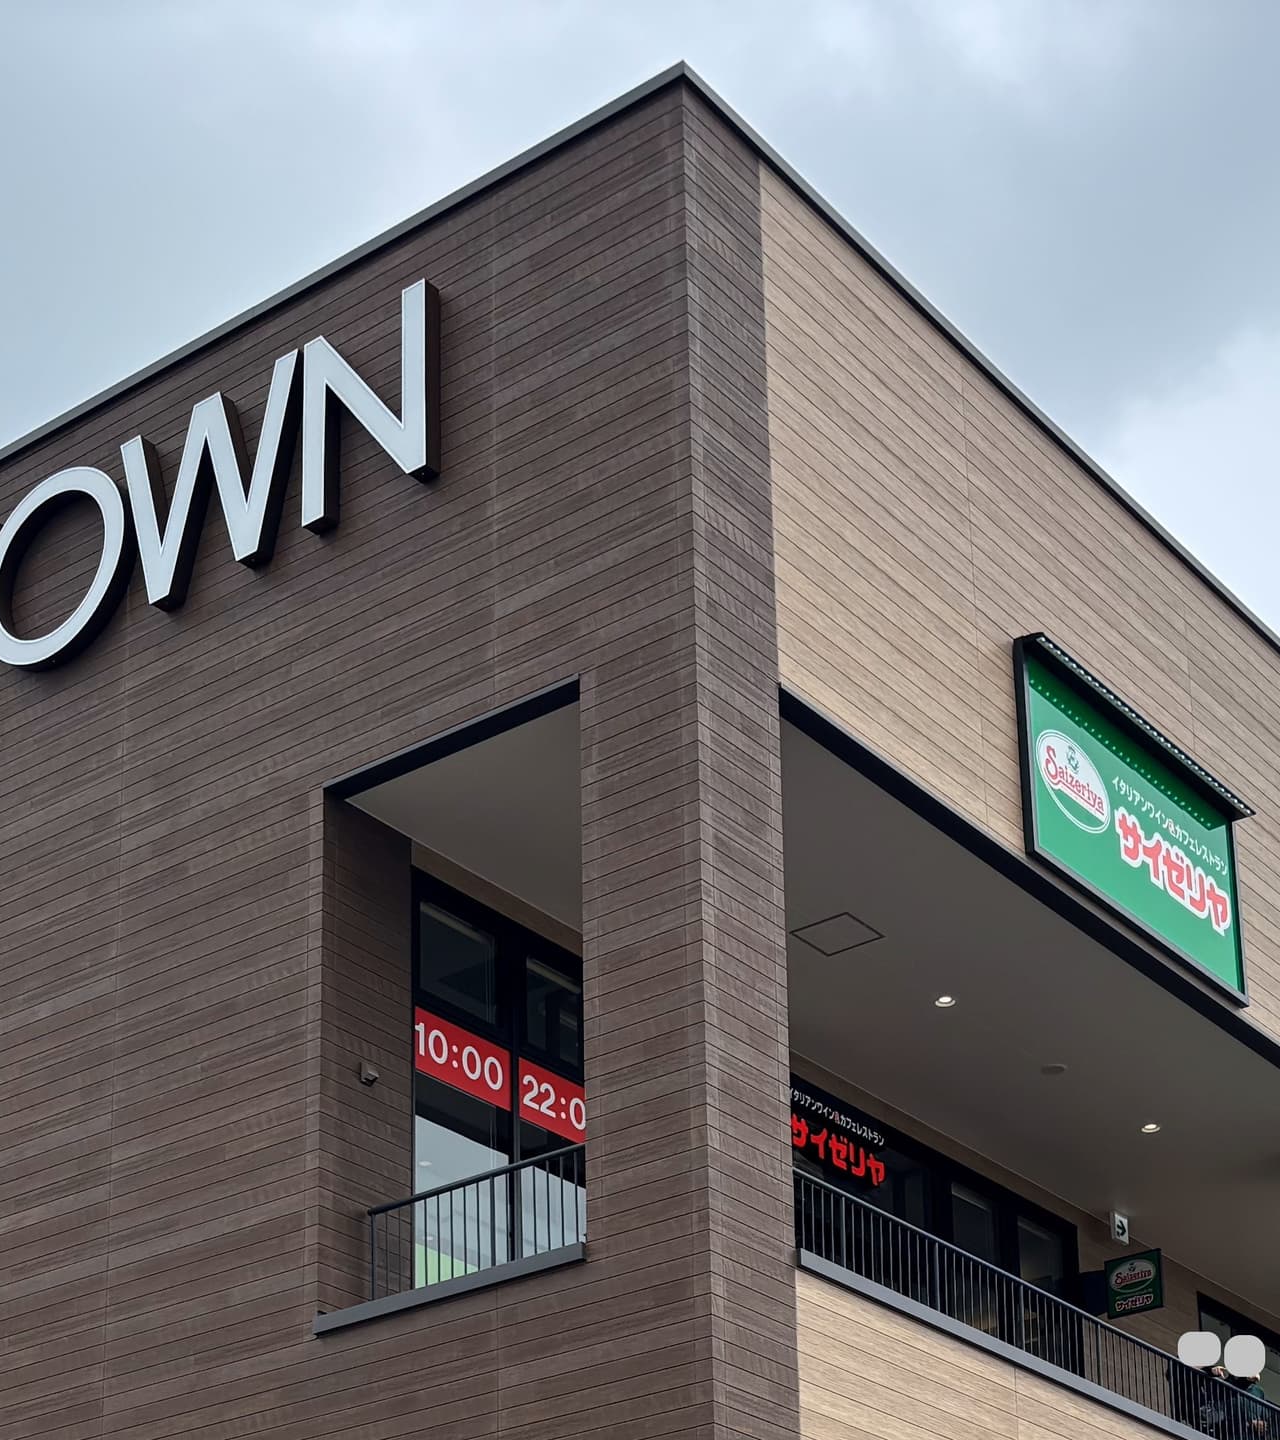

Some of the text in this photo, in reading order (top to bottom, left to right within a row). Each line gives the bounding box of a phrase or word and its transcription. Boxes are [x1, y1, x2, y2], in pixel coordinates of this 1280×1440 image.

[1045, 745, 1105, 812] Saizeriya
[1115, 808, 1230, 934] サイゼリヤ
[415, 1022, 587, 1130] 10:00 22:0
[791, 1112, 885, 1186] サイゼリヤ
